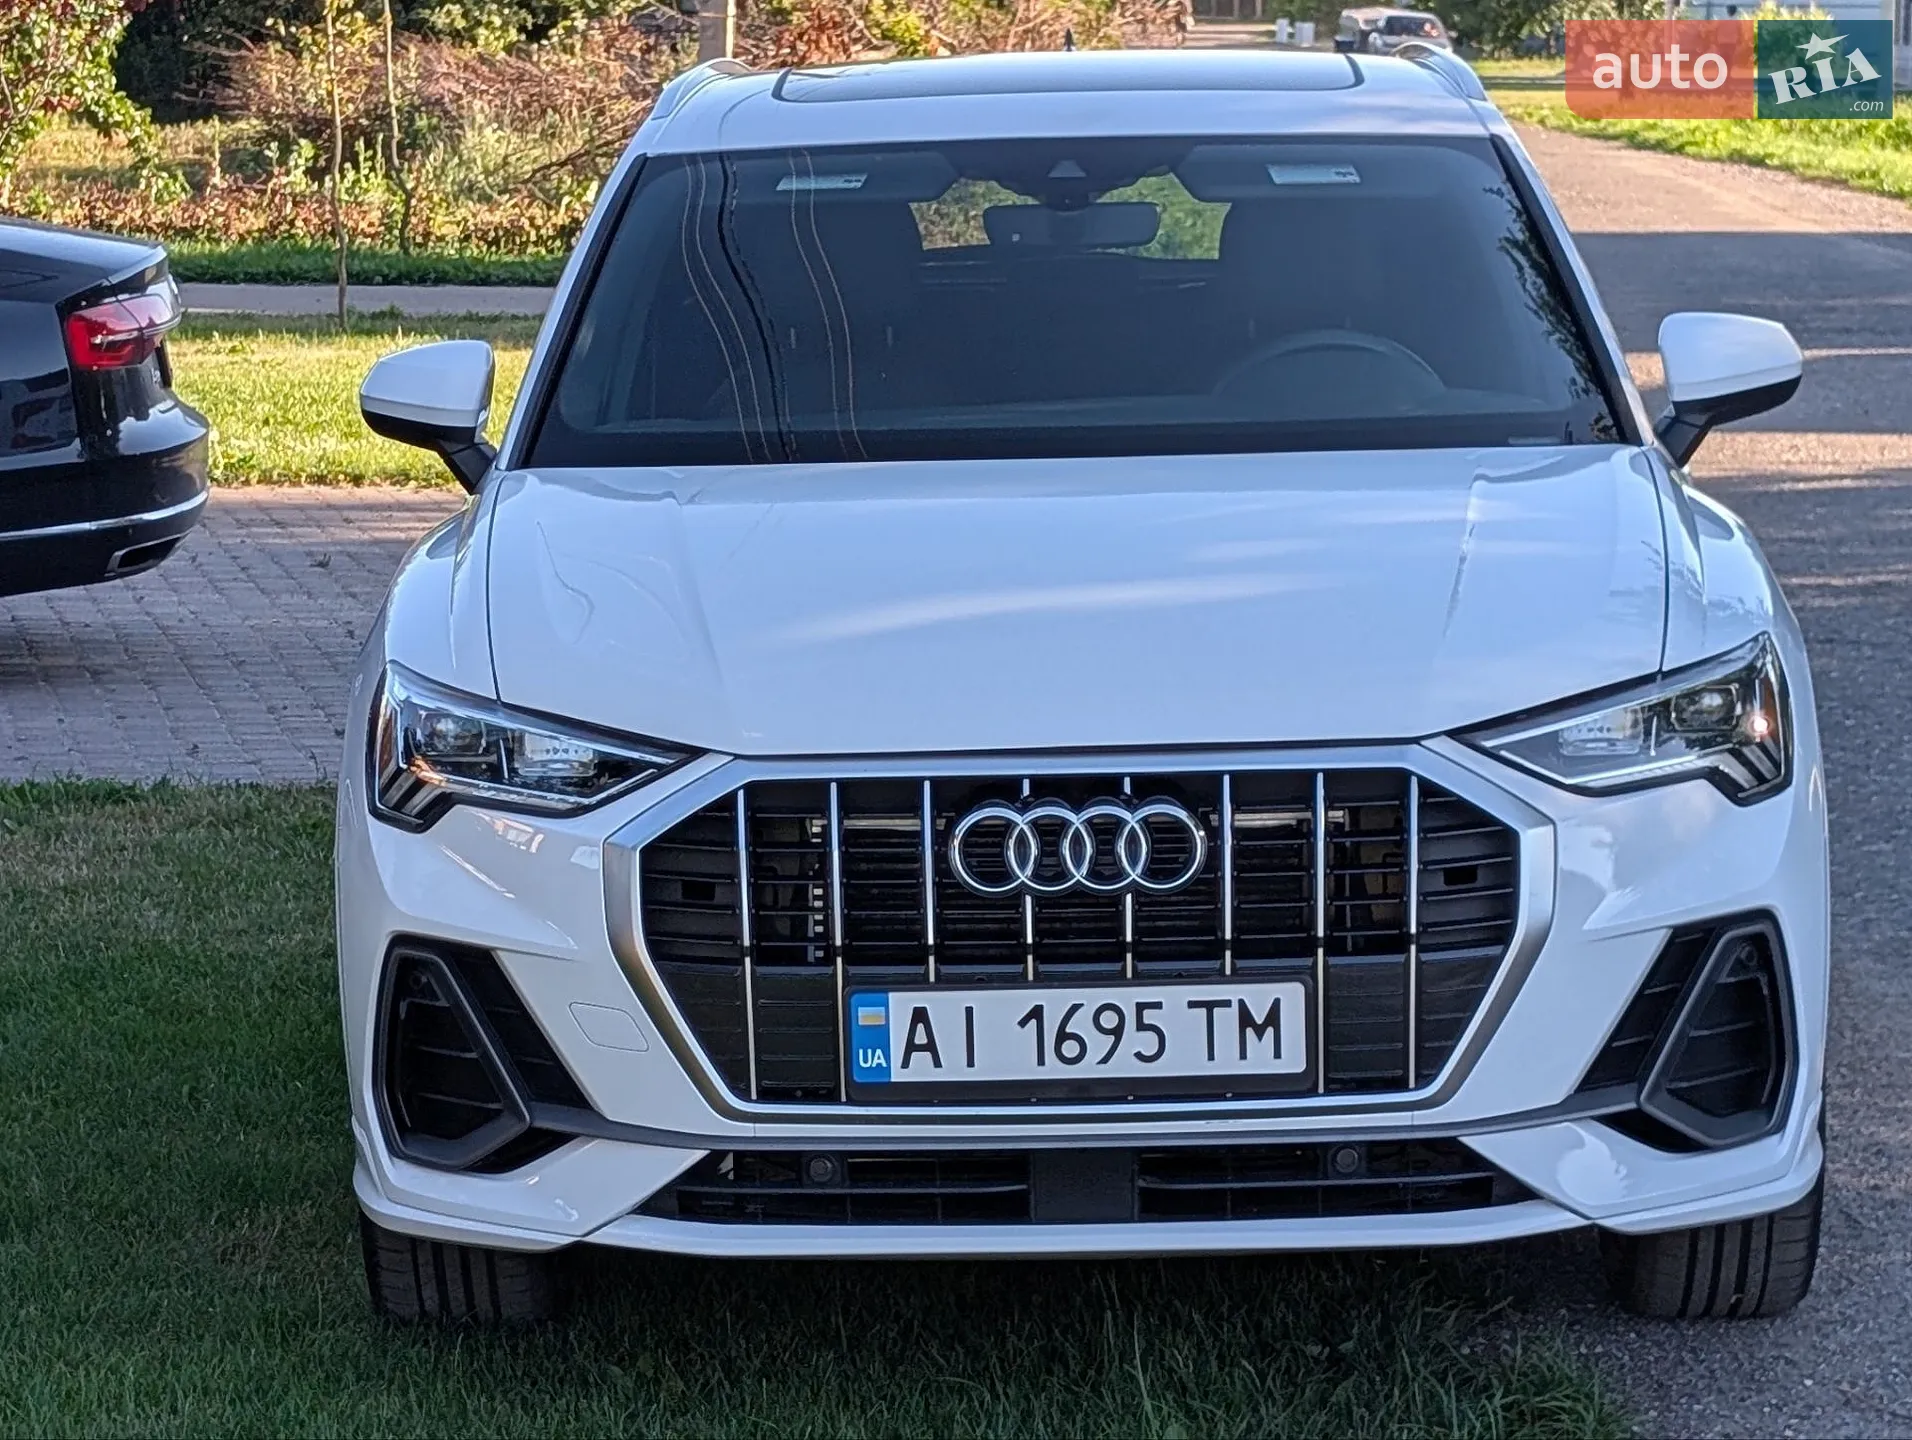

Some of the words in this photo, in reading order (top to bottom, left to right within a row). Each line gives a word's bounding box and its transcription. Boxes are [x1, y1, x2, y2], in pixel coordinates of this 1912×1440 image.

[901, 1006, 975, 1069] AI
[1017, 1000, 1167, 1067] 1695
[1188, 997, 1283, 1061] TM
[859, 1049, 887, 1068] UA
